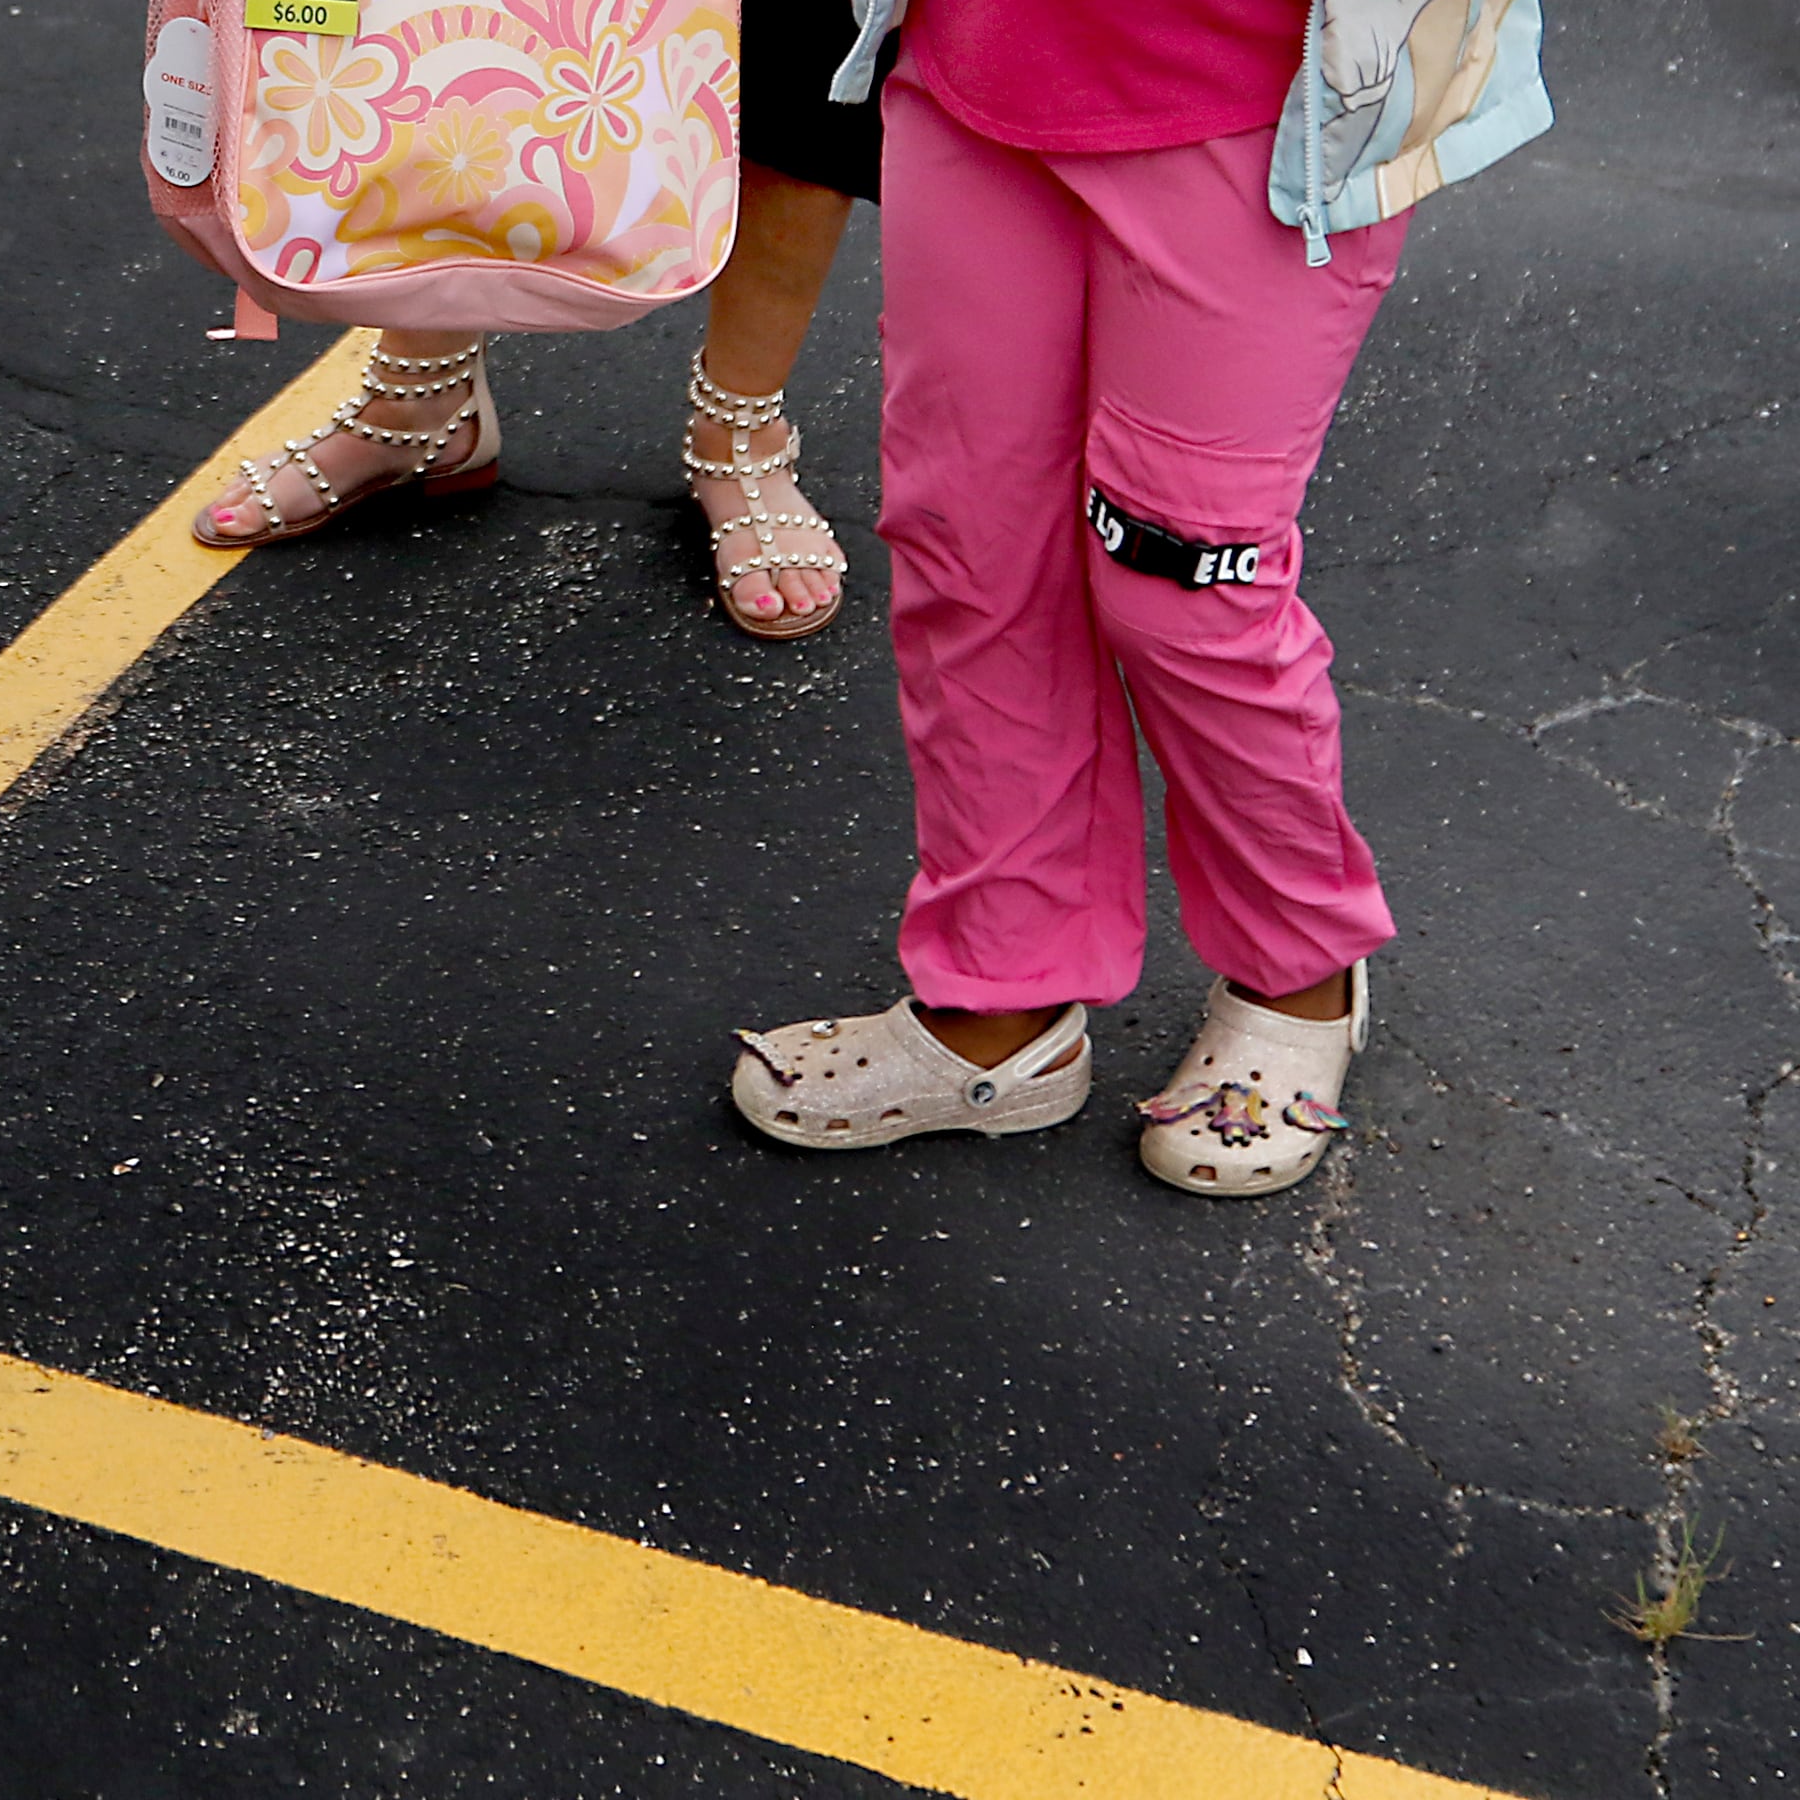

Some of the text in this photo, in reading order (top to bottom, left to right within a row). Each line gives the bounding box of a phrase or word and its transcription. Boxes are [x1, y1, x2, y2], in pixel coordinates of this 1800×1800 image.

[273, 1, 327, 25] $6.00
[161, 72, 185, 88] ONE
[1193, 546, 1261, 585] ELO
